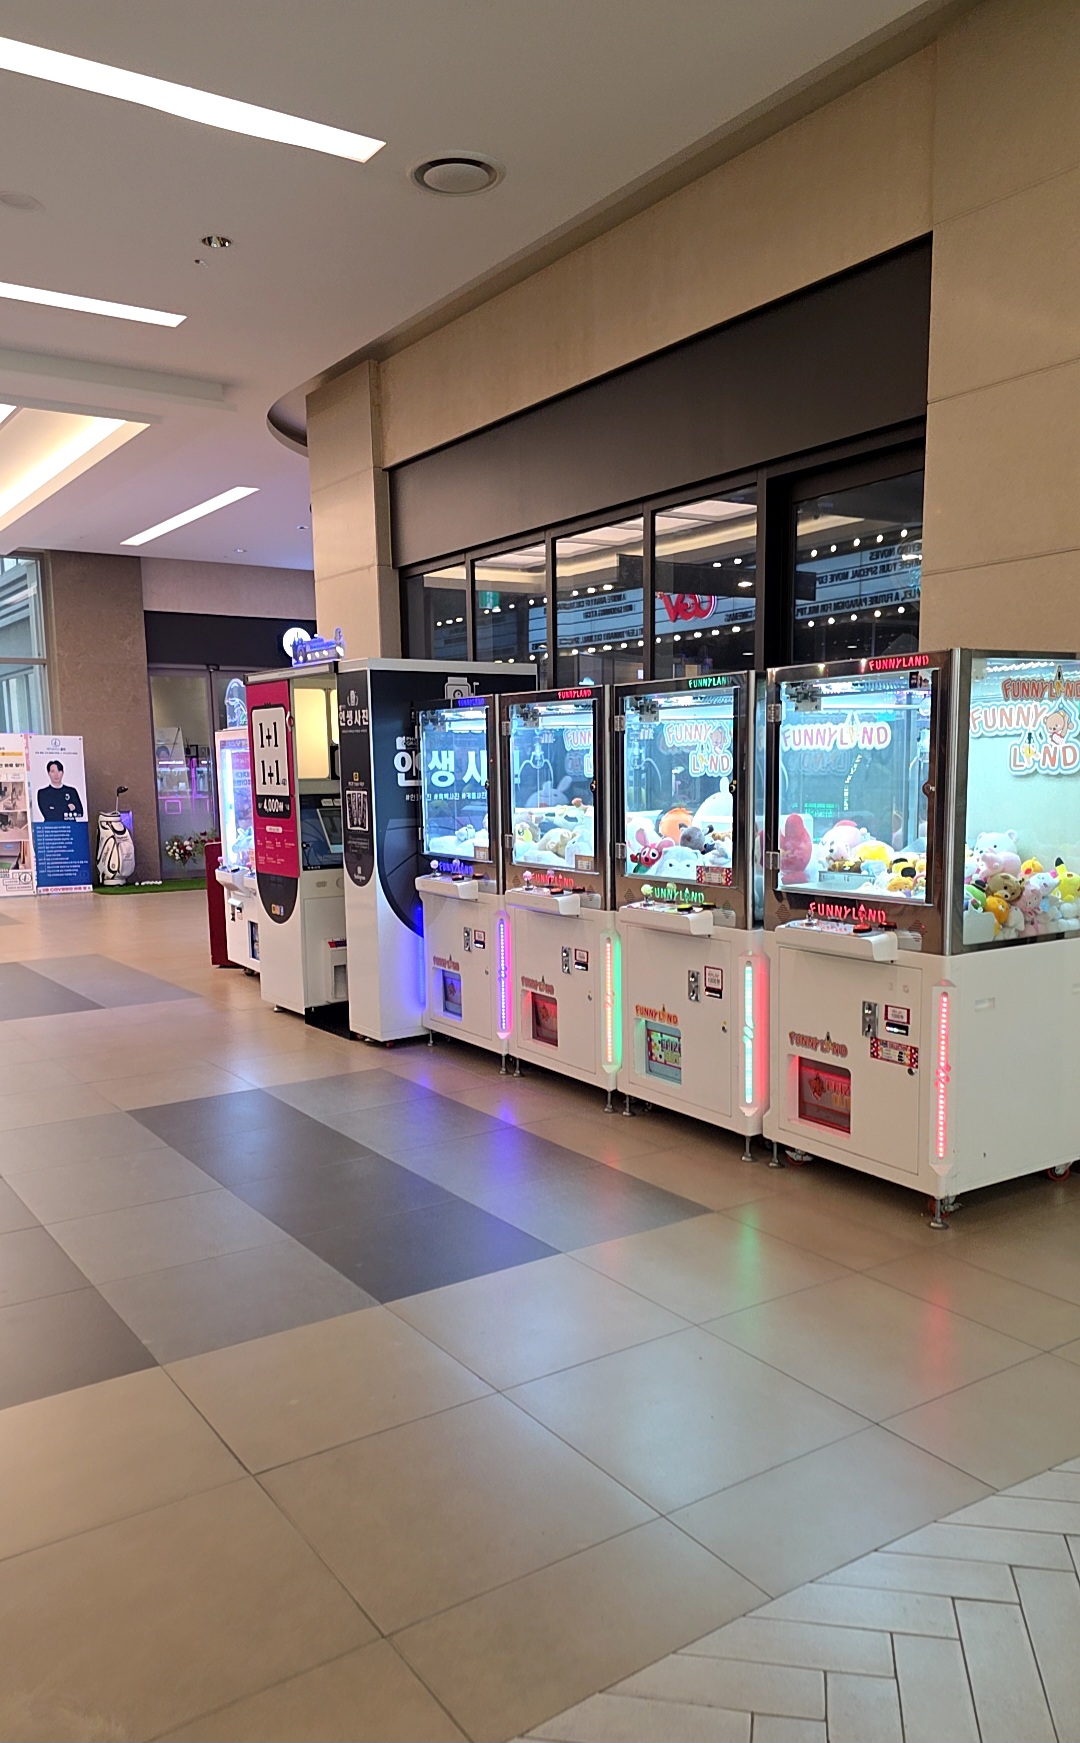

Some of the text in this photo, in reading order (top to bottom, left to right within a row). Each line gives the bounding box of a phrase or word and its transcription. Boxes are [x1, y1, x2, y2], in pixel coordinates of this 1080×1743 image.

[868, 655, 930, 672] FUNNYLAND
[557, 689, 592, 700] FUNNYLAND
[338, 708, 369, 727] 인생사진
[970, 703, 1050, 730] FUNNY
[258, 721, 279, 748] 1+1
[666, 724, 711, 746] FUNNY
[782, 722, 889, 747] FUNNYLAND
[691, 753, 731, 773] LAND
[1012, 743, 1079, 768] LAND
[260, 759, 281, 786] 1+1
[531, 872, 575, 888] FUNNYLAND
[649, 886, 705, 904] FUNNYLAND
[808, 901, 887, 923] FUNNYLAND
[635, 1003, 679, 1026] FUNNYLAND
[788, 1031, 848, 1058] FUNNYLAND
